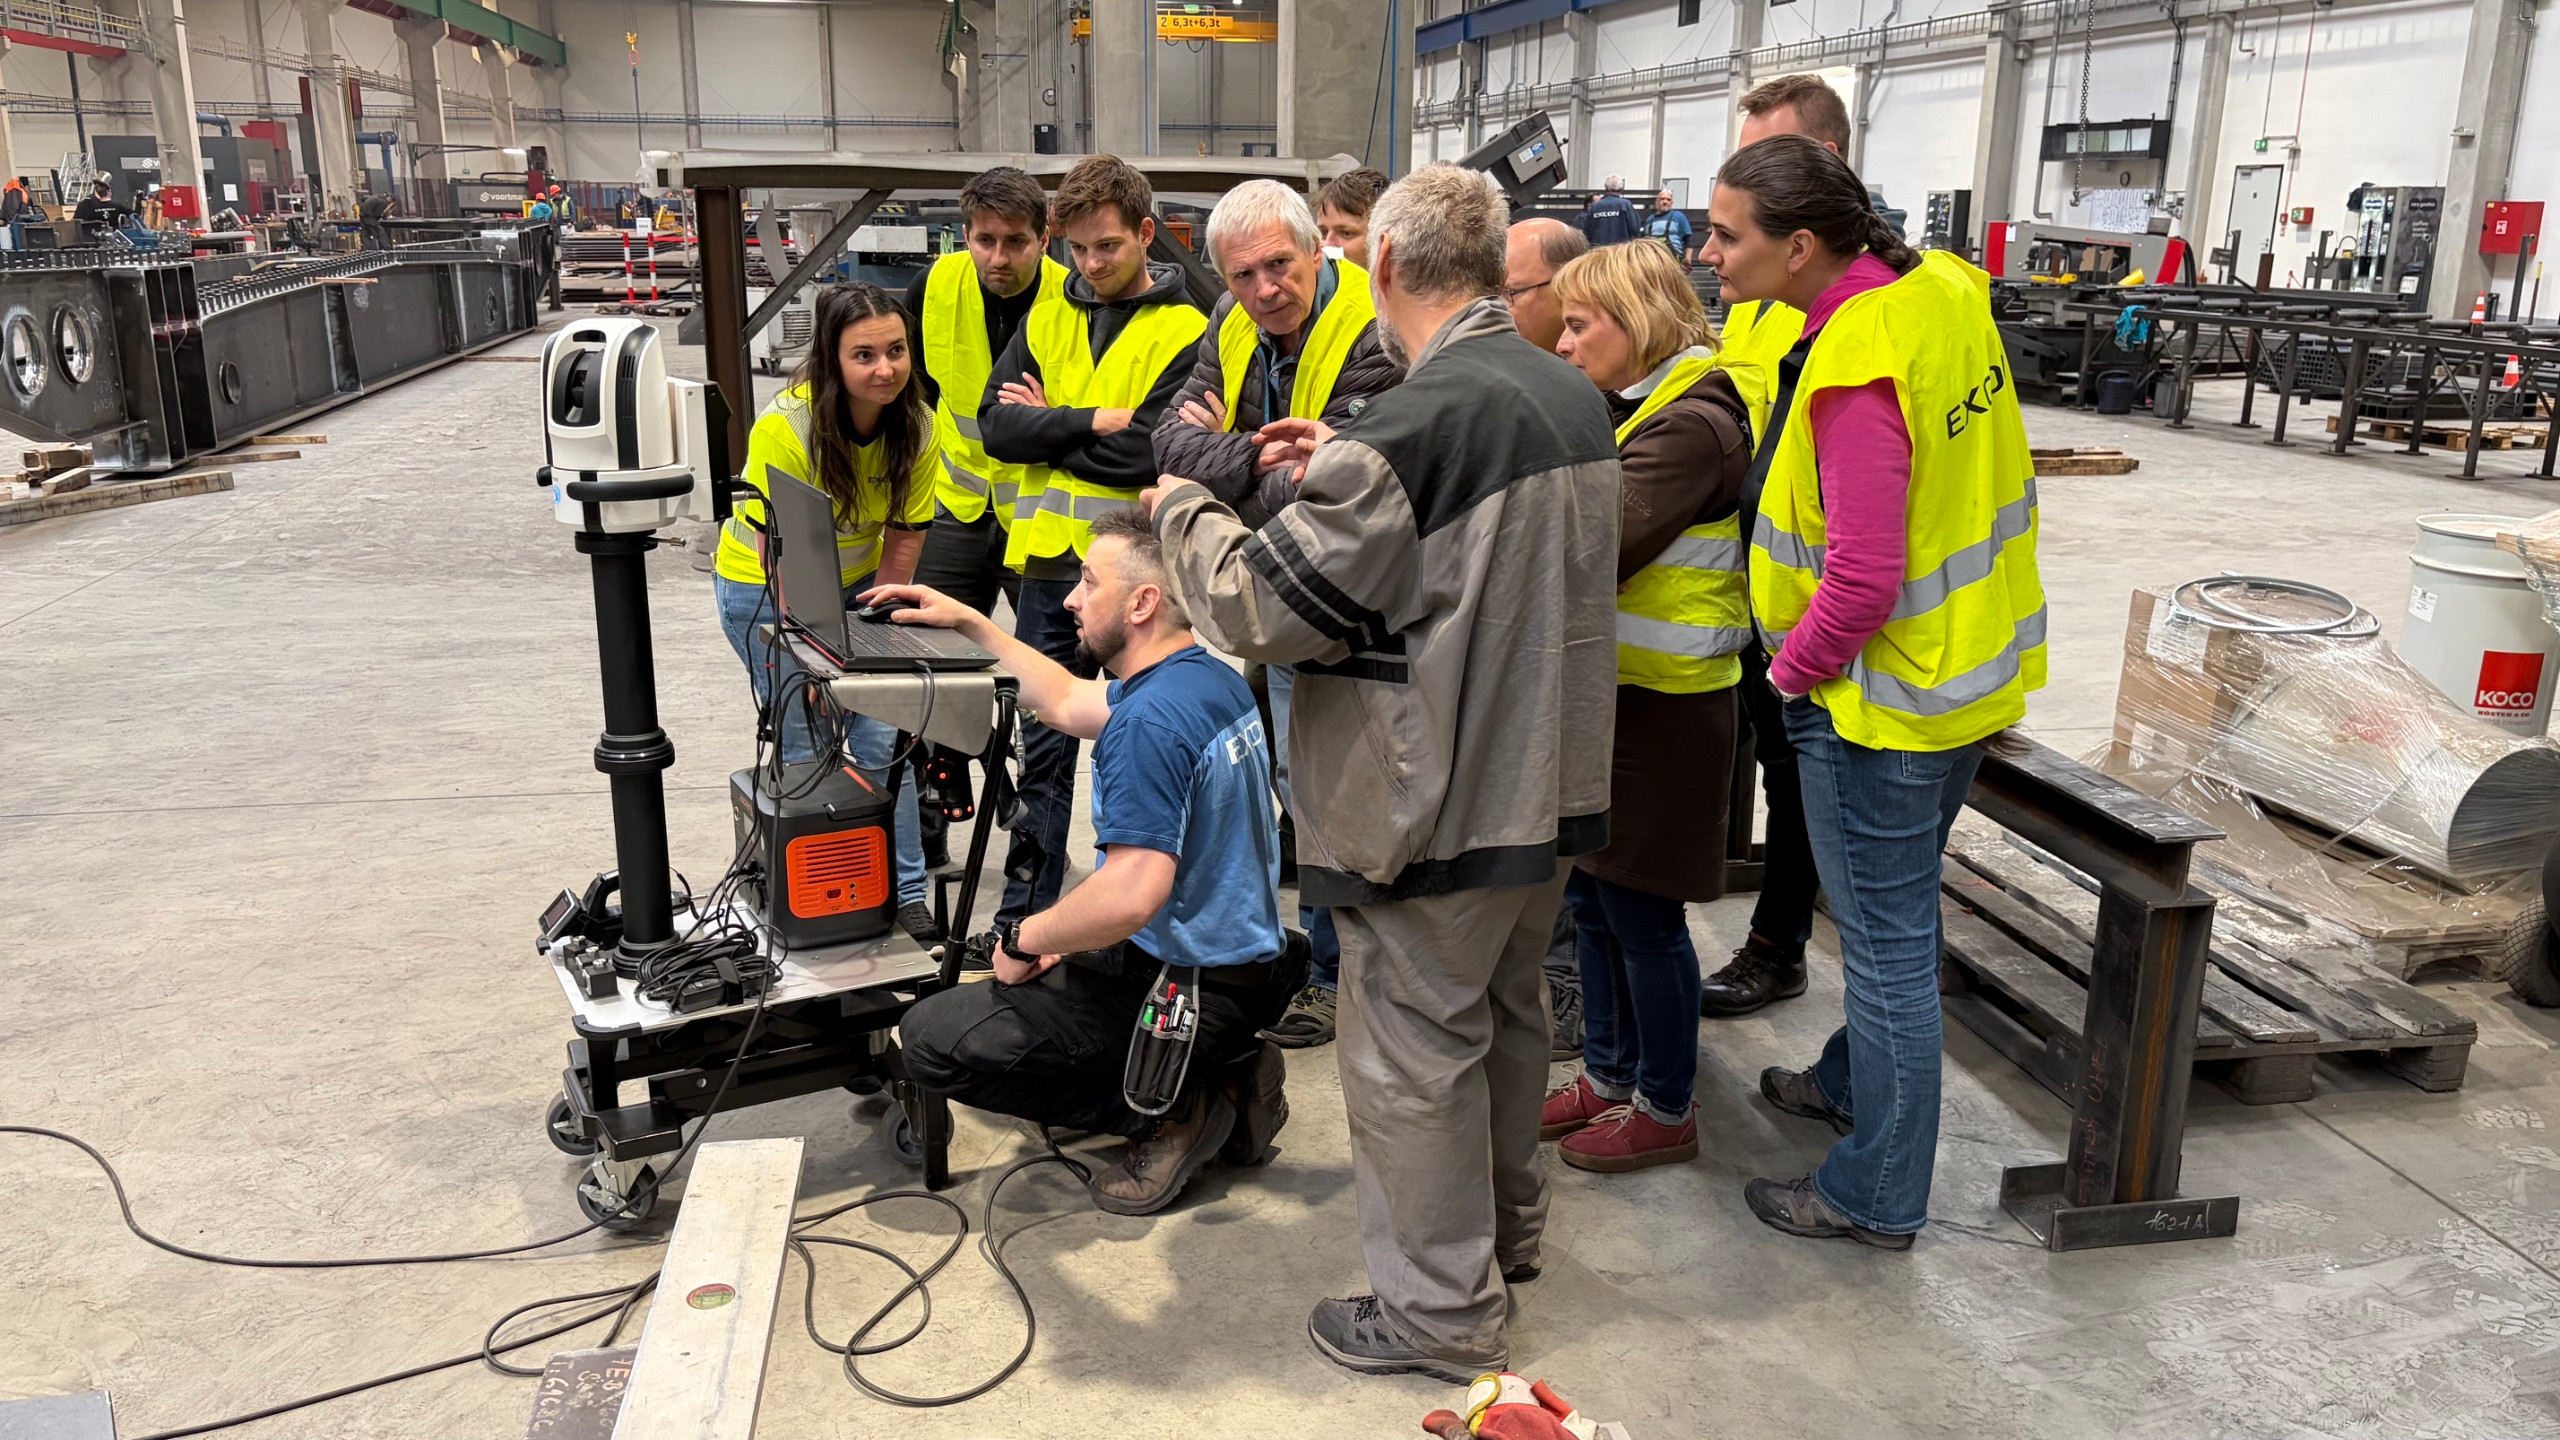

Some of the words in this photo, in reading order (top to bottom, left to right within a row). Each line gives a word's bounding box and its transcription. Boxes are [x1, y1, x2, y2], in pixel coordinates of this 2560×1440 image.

[1161, 17, 1168, 28] 2
[1172, 17, 1221, 29] 6,3t+6,3t
[490, 192, 528, 201] voortman
[1593, 210, 1620, 219] EXCON
